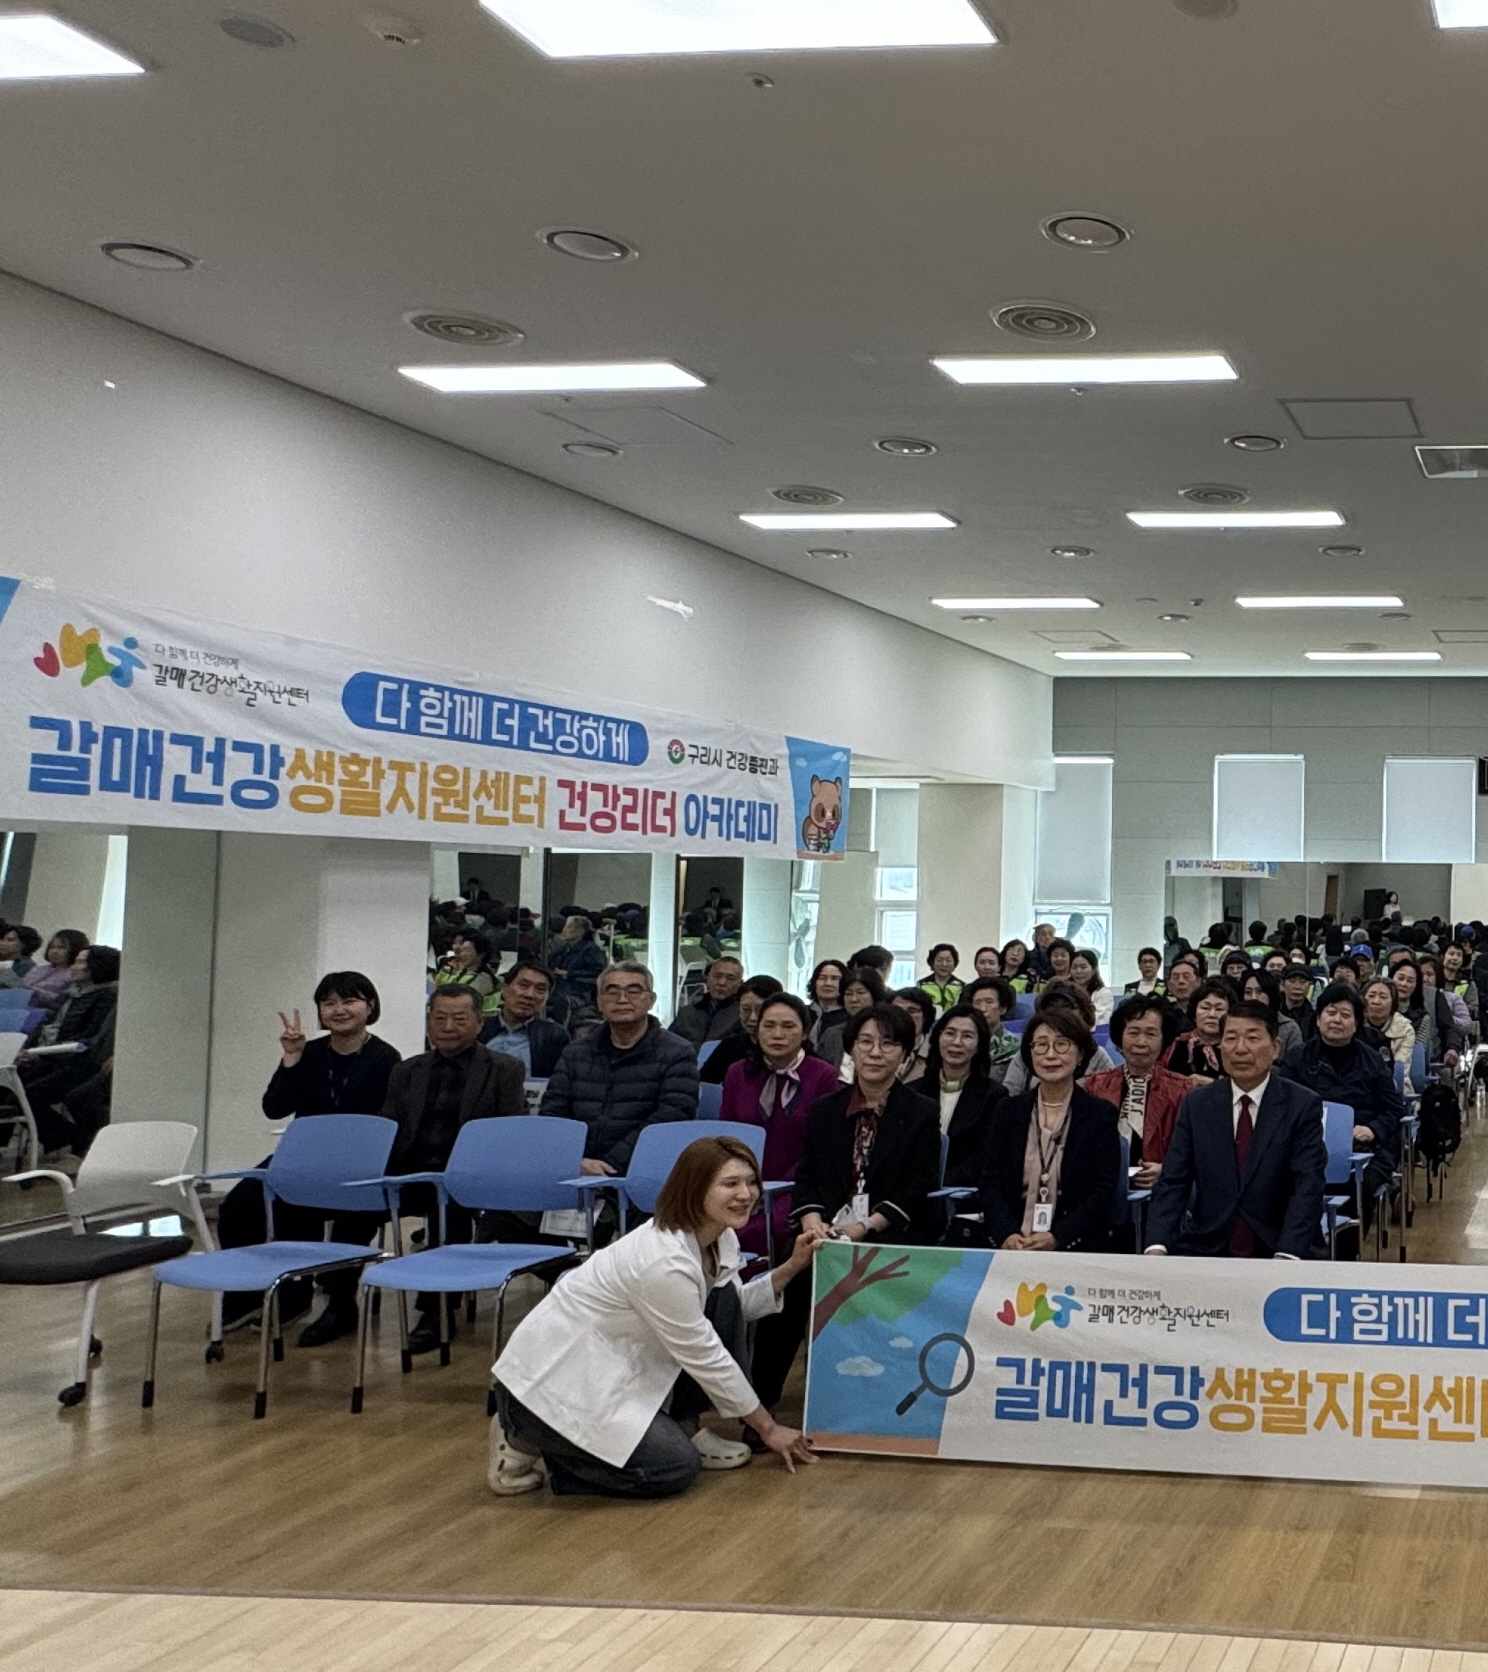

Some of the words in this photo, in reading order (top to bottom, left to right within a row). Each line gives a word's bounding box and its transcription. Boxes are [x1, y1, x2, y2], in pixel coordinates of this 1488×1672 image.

[154, 643, 166, 656] 다
[168, 645, 189, 662] 함께
[190, 650, 200, 663] 더
[202, 652, 240, 670] 건강하게
[375, 680, 410, 730] 다
[419, 686, 482, 740] 함께
[492, 700, 519, 746] 더
[527, 706, 631, 762] 건강하게
[688, 743, 722, 768] 구리시
[725, 750, 780, 777] 건강증진과
[556, 778, 678, 838] 건강리더
[684, 793, 779, 845] 아카데미
[1088, 1288, 1097, 1299] 다
[1099, 1289, 1116, 1300] 함께
[1117, 1289, 1126, 1299] 더
[1128, 1289, 1161, 1301] 건강하게
[1300, 1293, 1341, 1340] 다
[1351, 1293, 1433, 1343] 함께
[1447, 1298, 1486, 1345] 더
